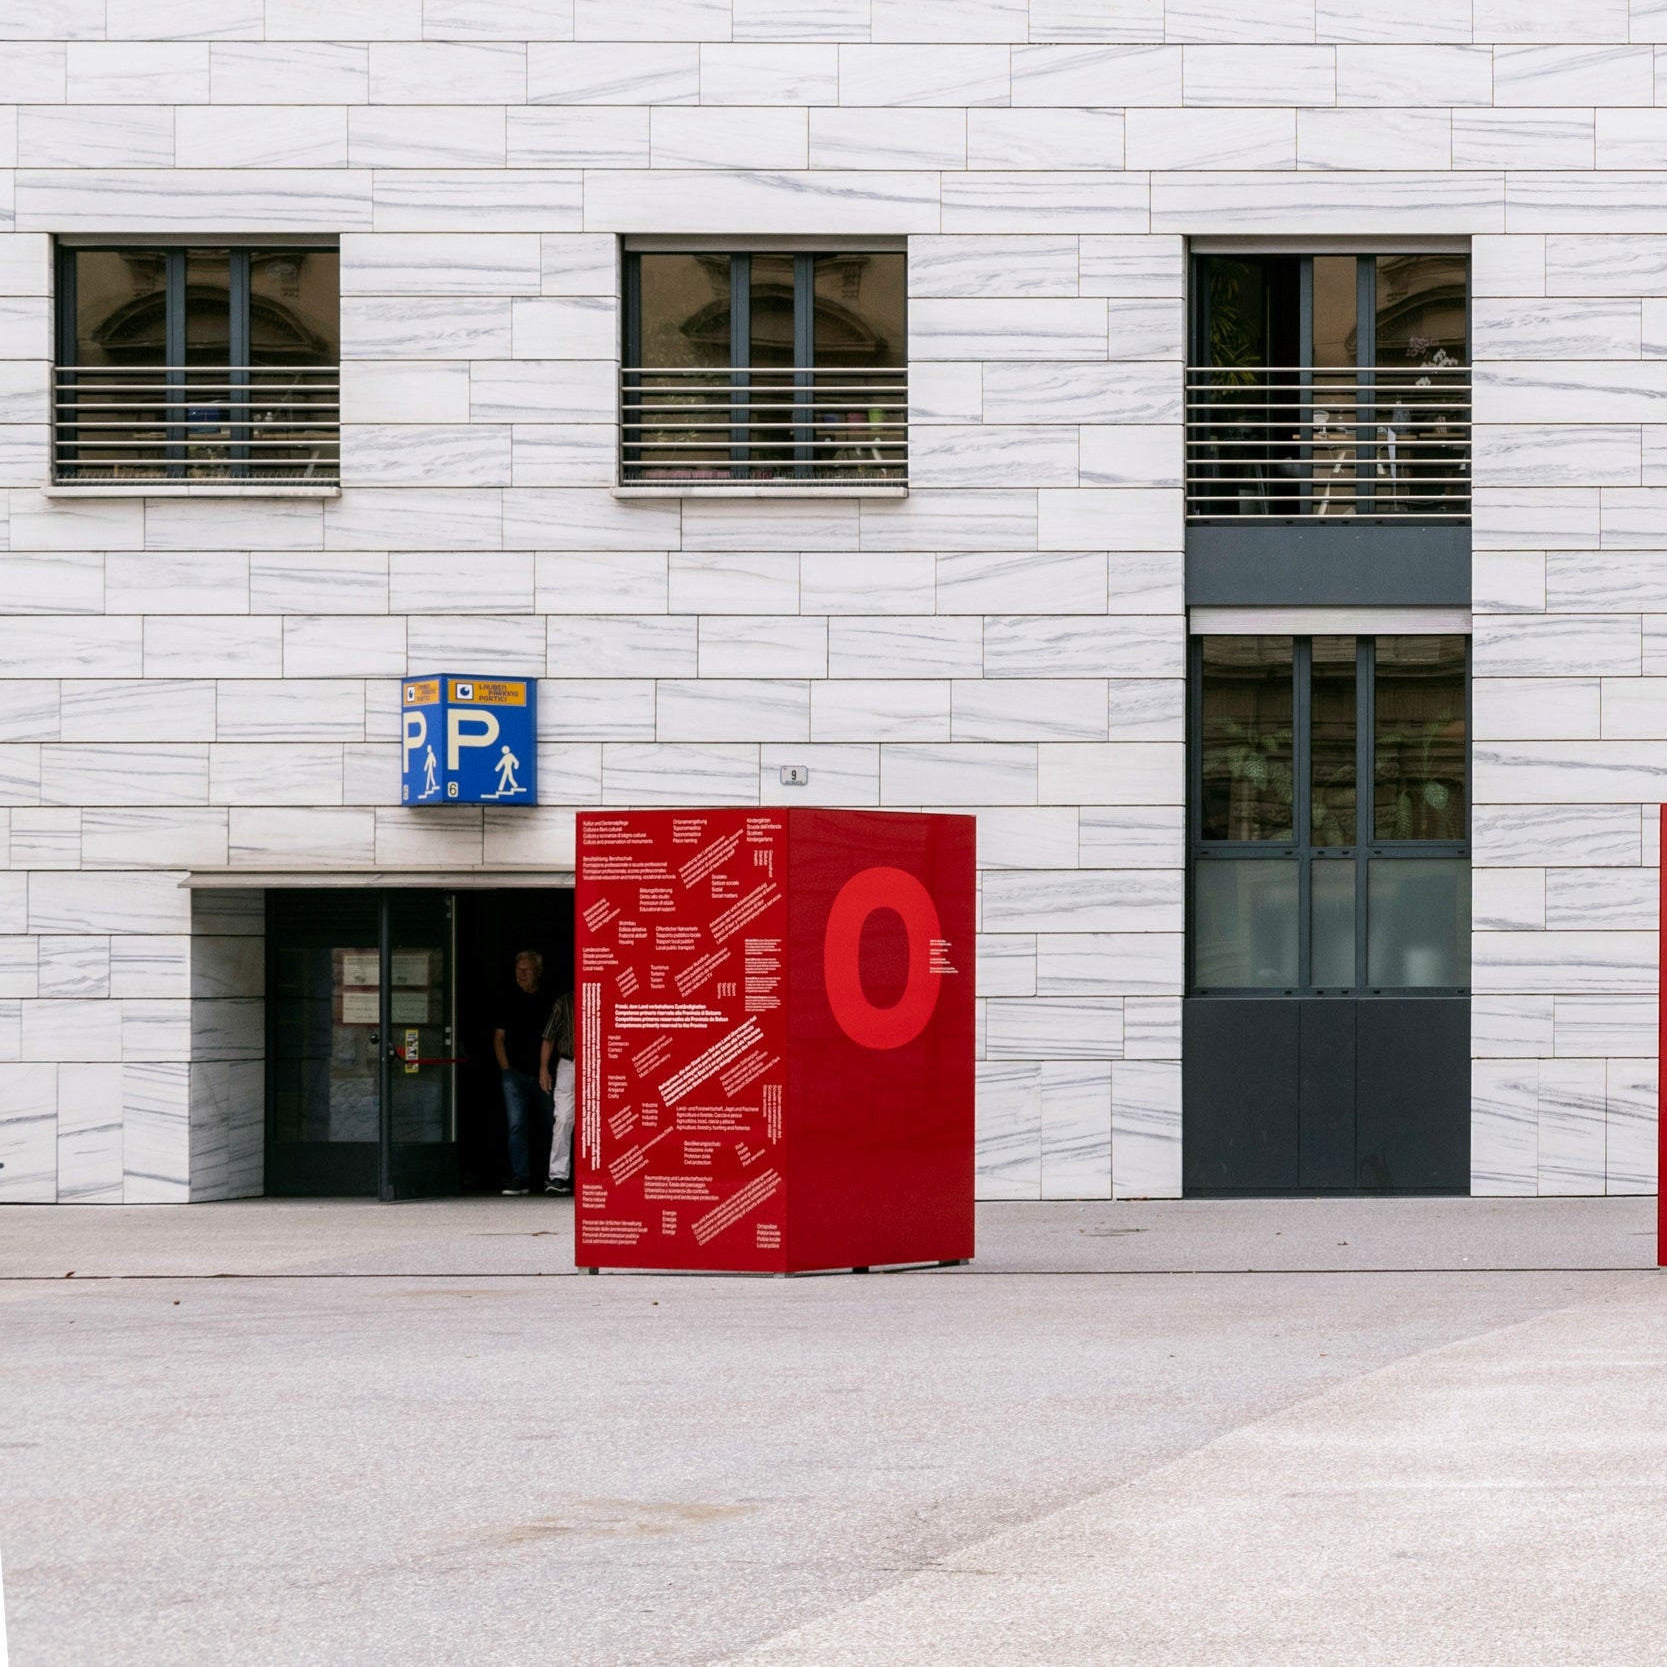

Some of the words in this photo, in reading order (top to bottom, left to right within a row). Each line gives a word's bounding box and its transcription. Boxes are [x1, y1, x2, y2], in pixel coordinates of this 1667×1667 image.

[403, 711, 427, 773] P
[448, 708, 500, 770] P
[449, 783, 457, 796] 6
[791, 770, 797, 780] 9
[824, 866, 942, 1050] 0
